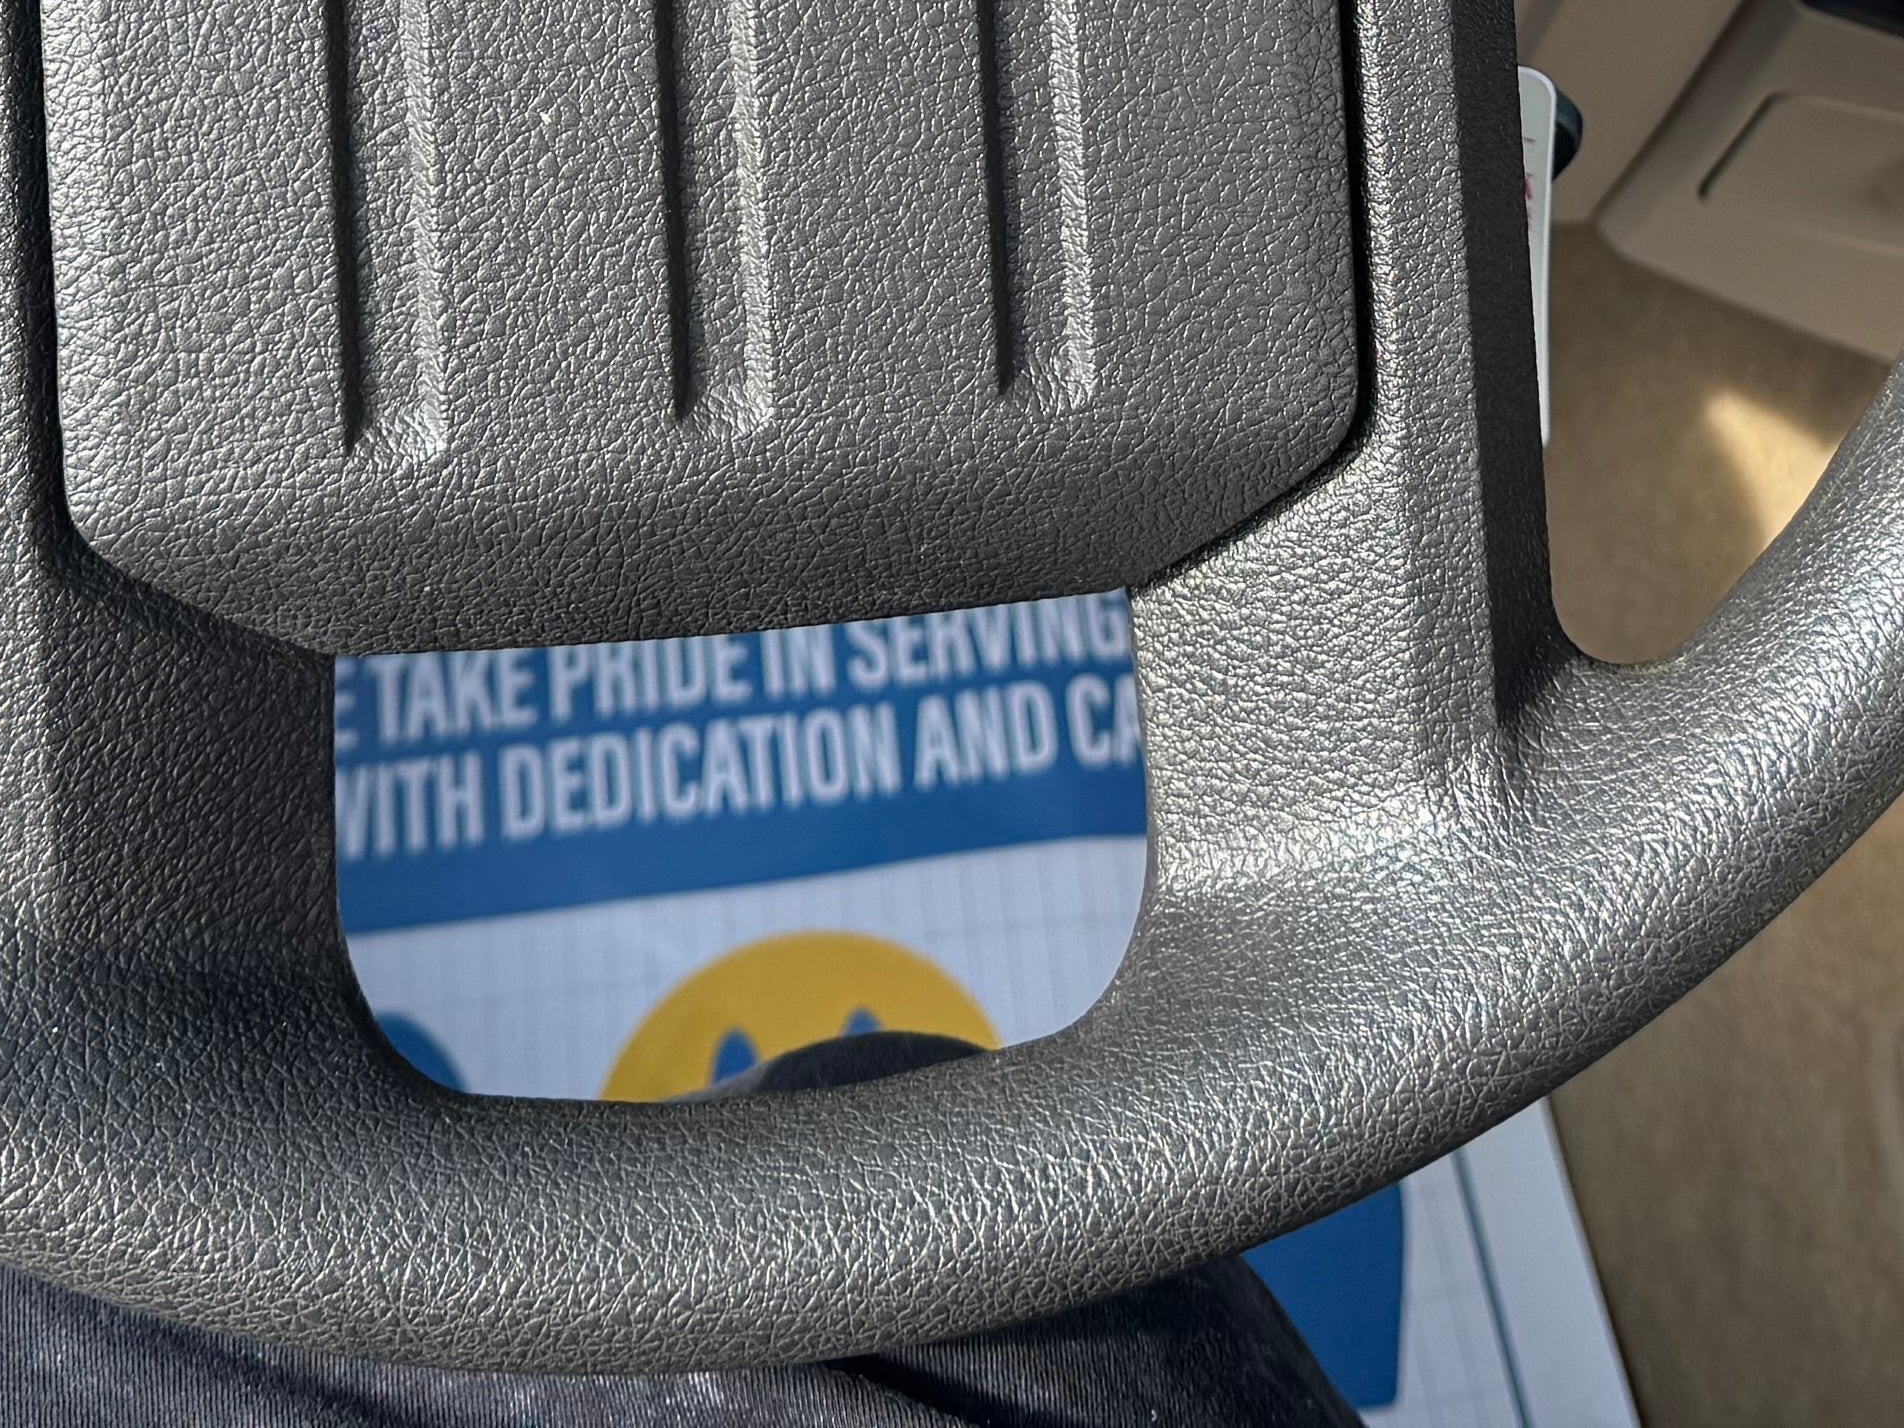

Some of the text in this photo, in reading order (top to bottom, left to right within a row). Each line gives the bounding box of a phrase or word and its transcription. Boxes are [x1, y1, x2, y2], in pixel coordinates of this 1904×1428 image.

[366, 647, 537, 742] TAKE
[548, 635, 751, 722] PRIDE
[764, 623, 834, 699] IN
[844, 592, 1133, 690] SERVING
[500, 707, 902, 841] DEDICATION
[913, 683, 1055, 788] AND
